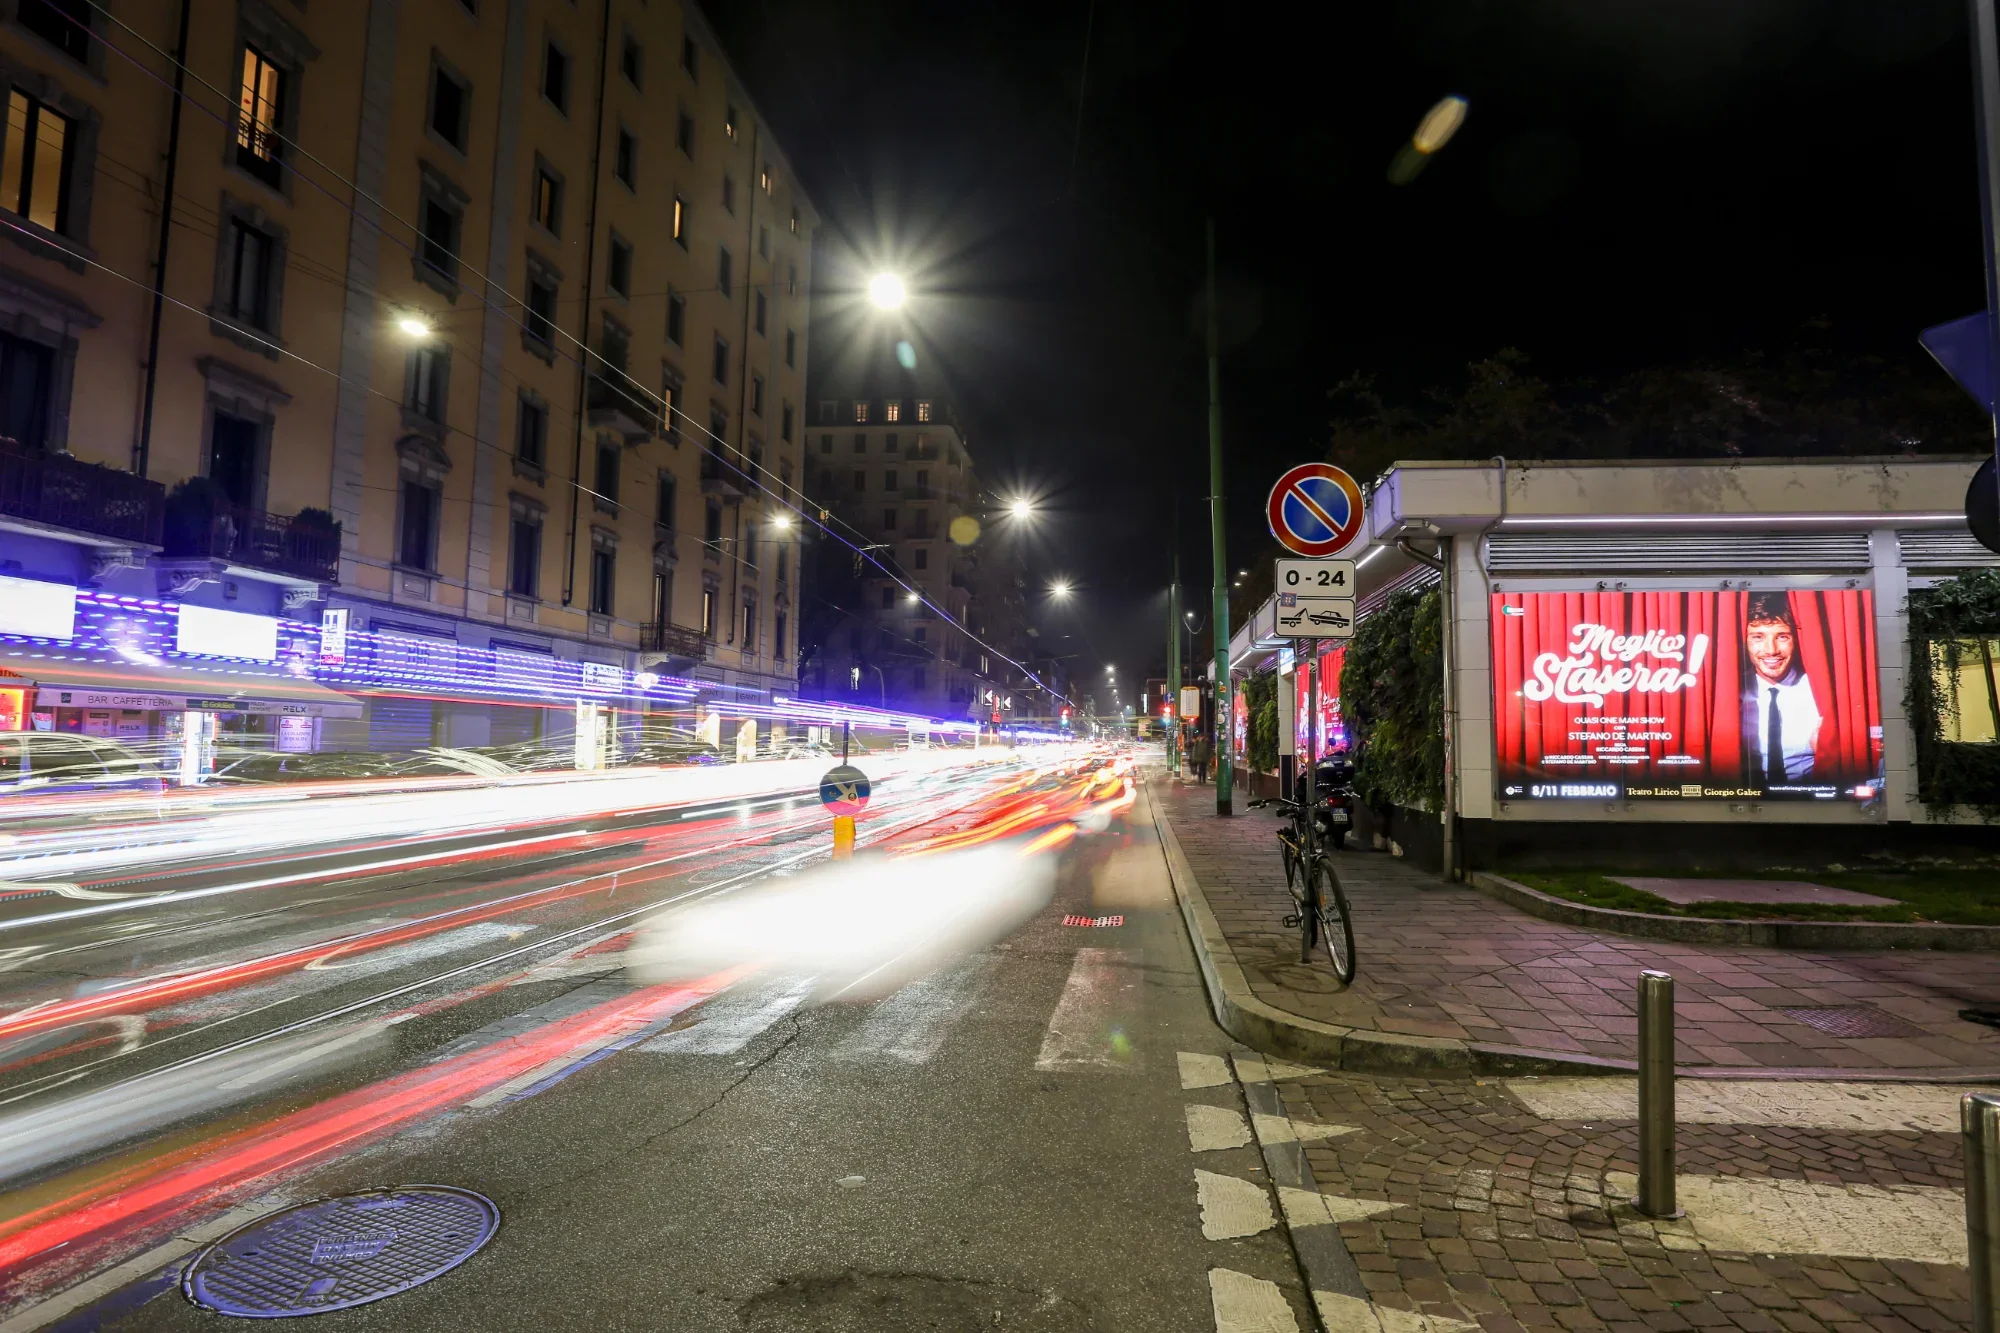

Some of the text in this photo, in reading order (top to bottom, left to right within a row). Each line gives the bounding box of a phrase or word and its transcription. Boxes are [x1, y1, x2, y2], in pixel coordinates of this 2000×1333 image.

[1286, 570, 1300, 586] 0
[1317, 570, 1345, 587] 24
[1569, 623, 1686, 661] Meglio
[1524, 634, 1709, 708] Stasera!
[88, 696, 173, 706] BAR CAFFETTERIA
[740, 693, 757, 701] GANT
[283, 705, 306, 713] RELX
[1568, 732, 1672, 740] STEFANO DE MARTINO
[1531, 785, 1557, 797] 8/11
[1561, 785, 1617, 797] FEBBRAIO
[1626, 787, 1680, 796] Teatro Lirico
[1704, 788, 1762, 797] Giorgio Gaber
